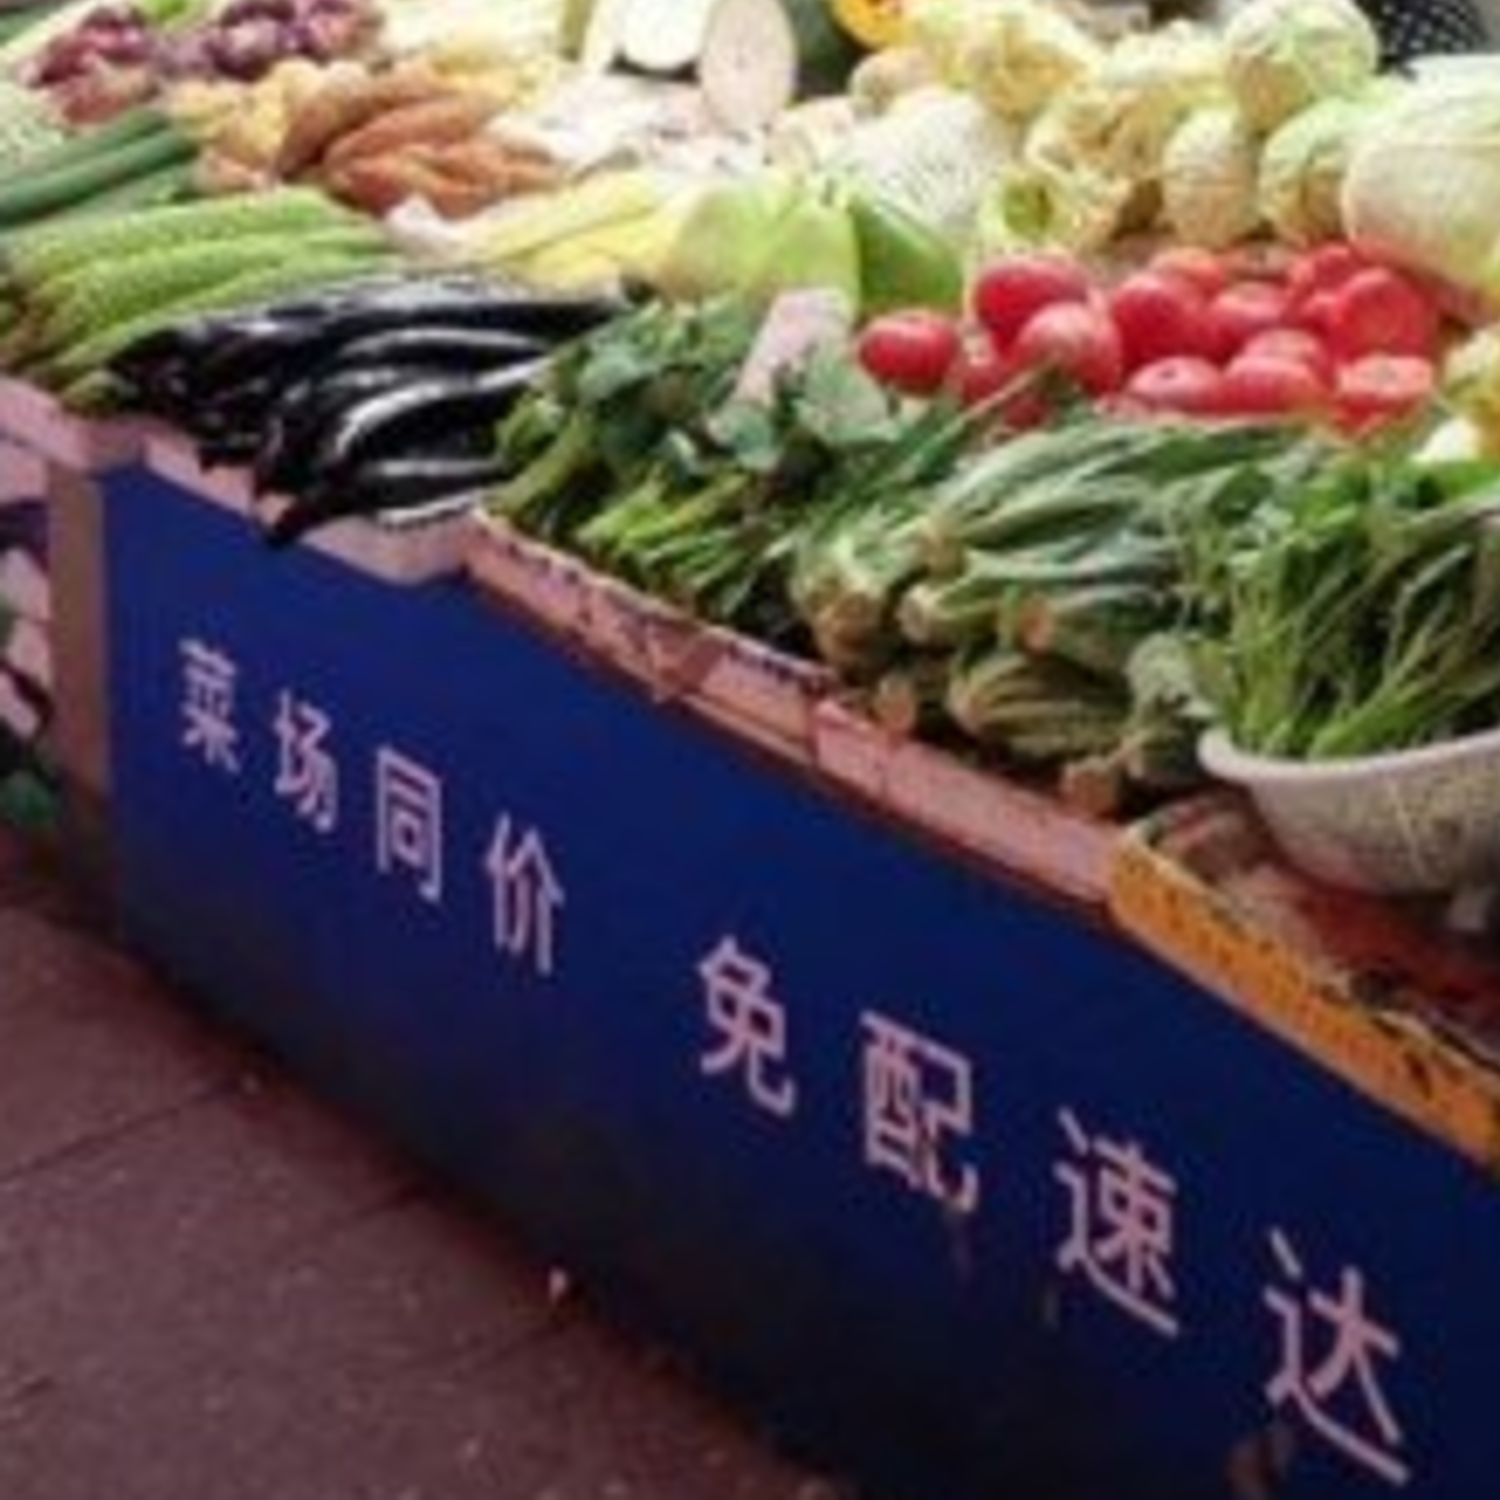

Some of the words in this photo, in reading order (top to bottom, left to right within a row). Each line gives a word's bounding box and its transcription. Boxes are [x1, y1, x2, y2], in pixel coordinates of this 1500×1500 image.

[178, 638, 566, 975] 菜场同价
[697, 935, 1410, 1488] 免配速达
